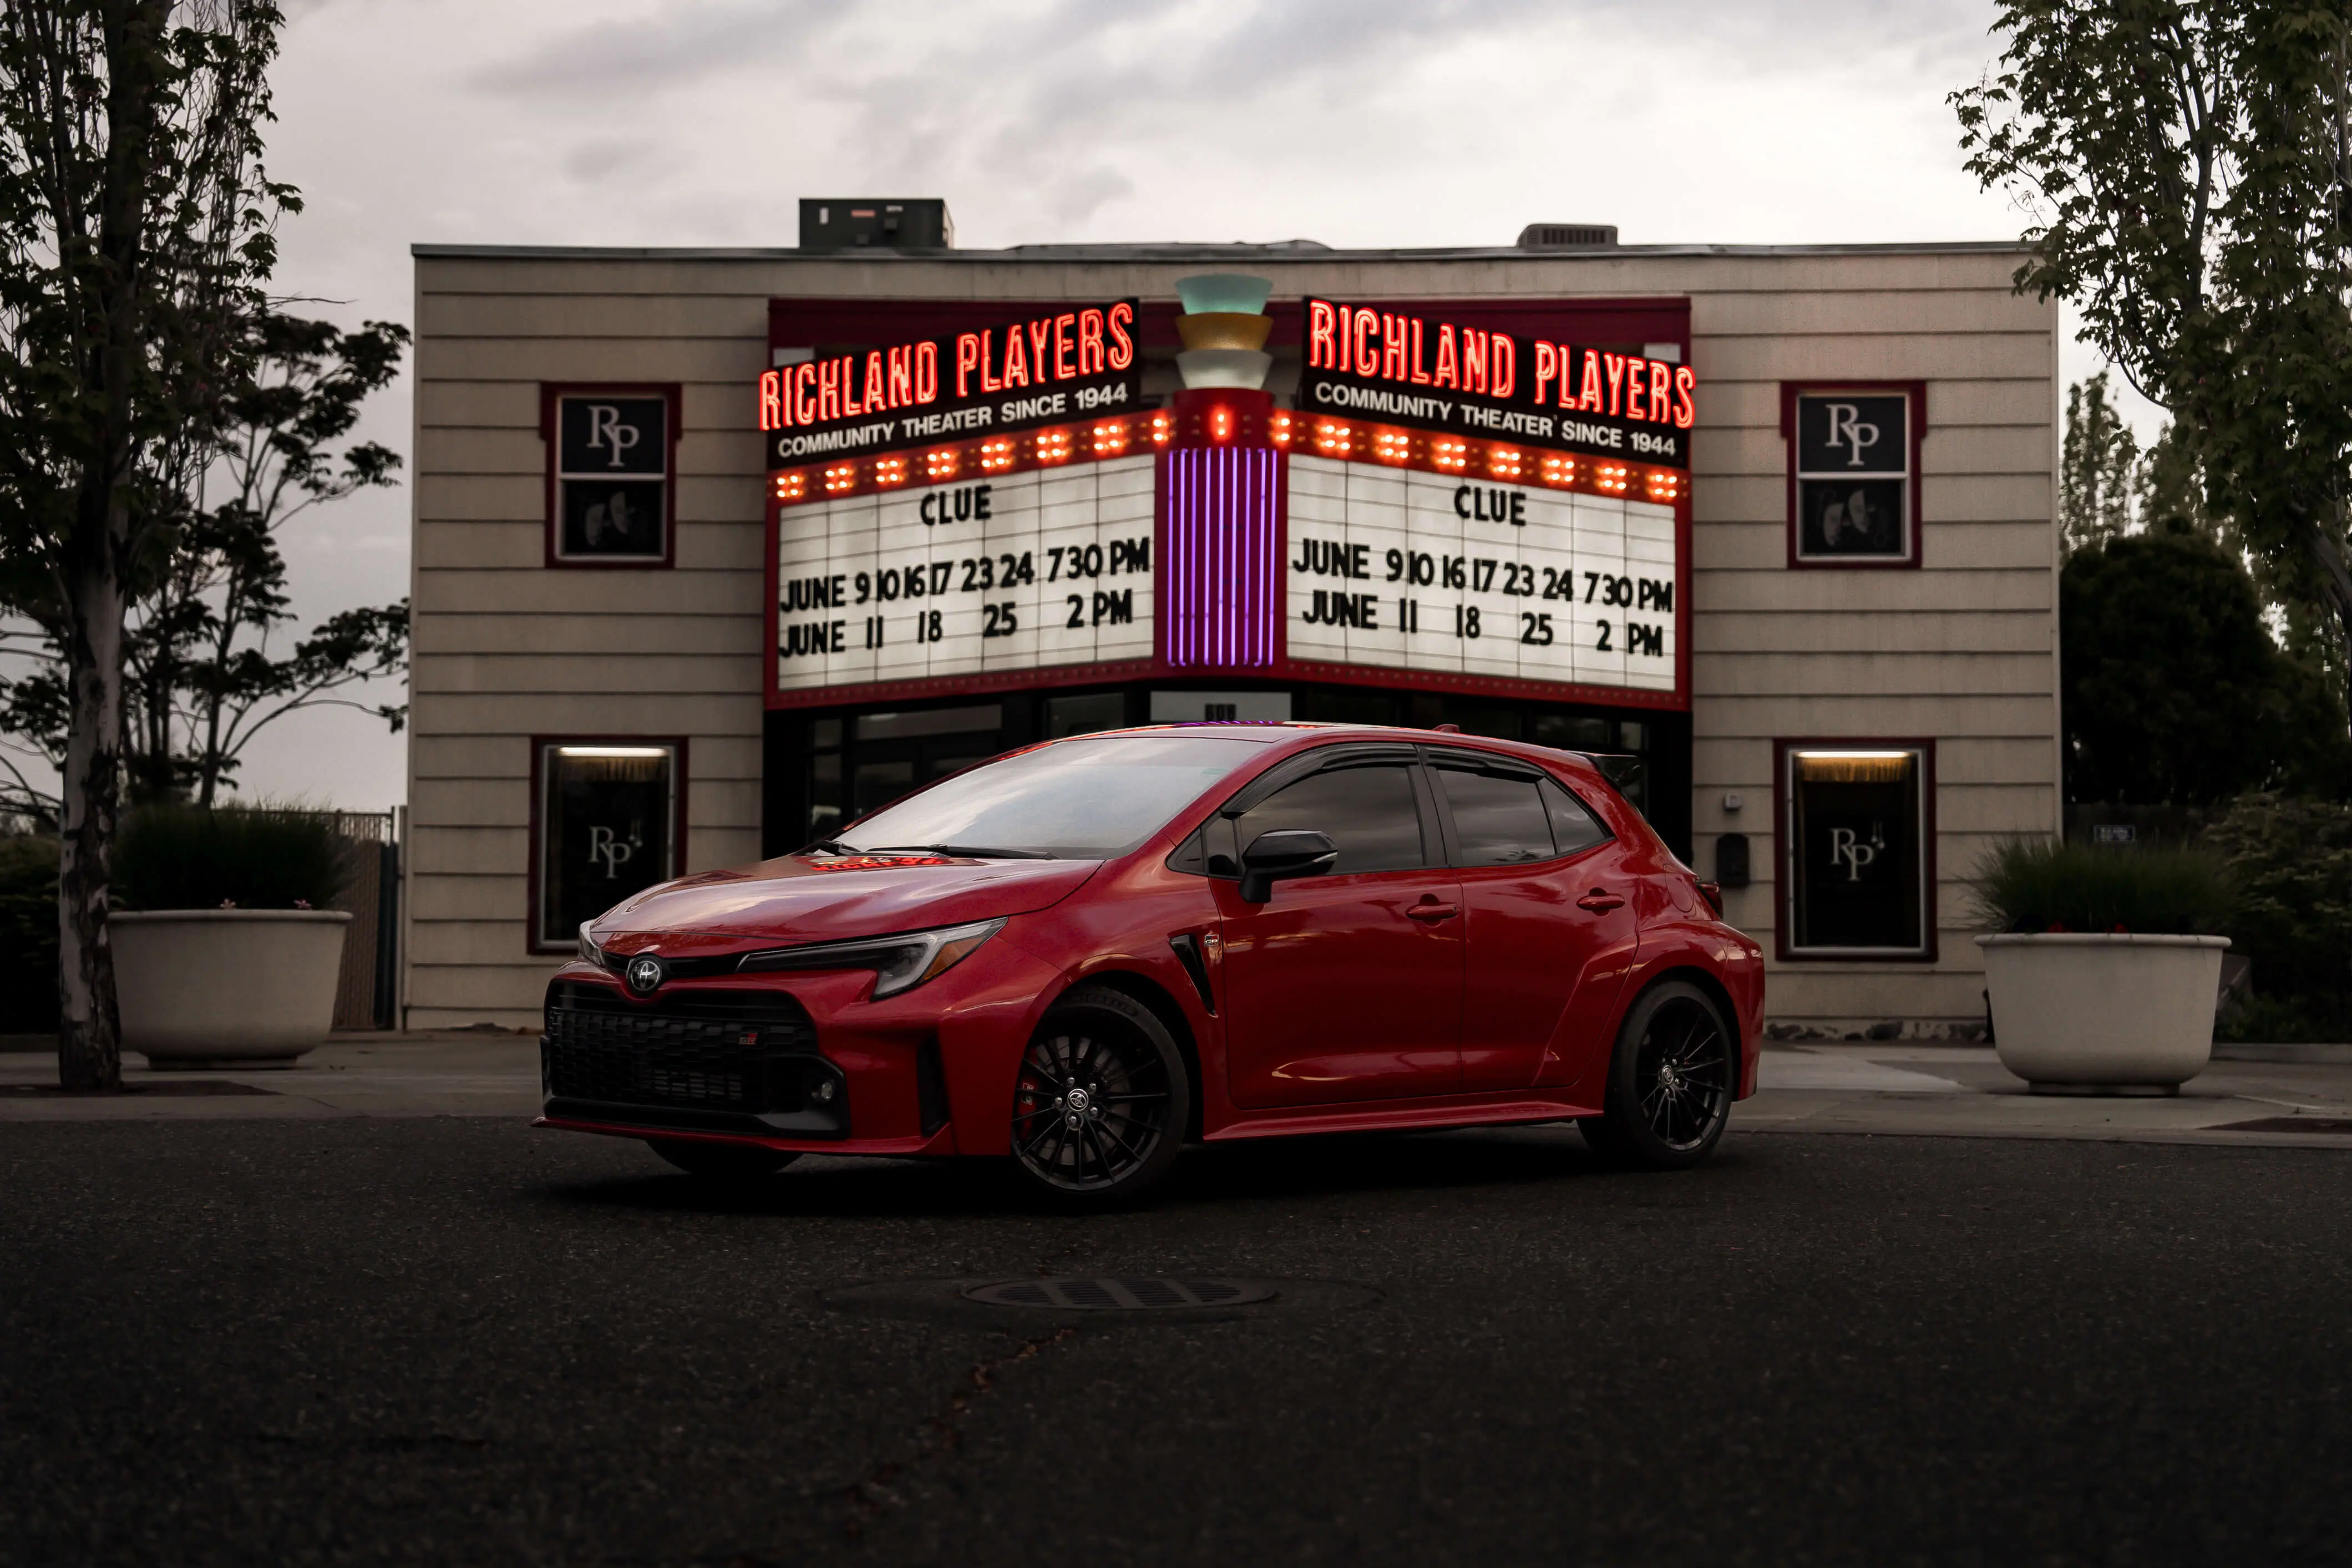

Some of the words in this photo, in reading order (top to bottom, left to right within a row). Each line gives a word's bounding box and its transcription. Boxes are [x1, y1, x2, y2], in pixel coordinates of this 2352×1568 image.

[760, 341, 938, 430] RICHLAND
[957, 302, 1133, 397] PLAYERS
[1309, 300, 1515, 398] RICHLAND
[1535, 341, 1696, 428] PLAYERS
[586, 405, 640, 466] RP
[778, 421, 895, 458] COMMUNITY
[903, 406, 992, 438] THEATER
[1001, 393, 1066, 423] SINCE
[1075, 382, 1127, 411] 1944
[1316, 382, 1452, 421] COMMUNITY
[1461, 405, 1553, 437] THEATER
[1562, 420, 1621, 448] SINCE
[1630, 432, 1675, 455] 1944
[1825, 404, 1880, 466] RP
[920, 484, 992, 526] CLUE
[1454, 485, 1526, 526] CLUE
[781, 575, 845, 612] JUNE
[855, 572, 869, 604] 9
[877, 568, 900, 602] 10
[904, 565, 925, 598] 16
[931, 561, 953, 595] 17
[961, 557, 993, 592] 23
[1000, 552, 1034, 587] 24
[1110, 537, 1150, 576] PM
[1293, 538, 1370, 580] JUNE
[1386, 549, 1402, 581] 9
[1410, 553, 1433, 586] 10
[1443, 554, 1466, 589] 16
[1473, 559, 1497, 592] 17
[1503, 563, 1534, 597] 23
[1543, 567, 1573, 602] 24
[1638, 579, 1672, 613] PM
[778, 621, 845, 658] JUNE
[866, 616, 883, 649] 11
[918, 611, 941, 643] 18
[982, 602, 1017, 637] 25
[1067, 595, 1083, 628] 2
[1092, 588, 1132, 626] PM
[1302, 590, 1378, 630] JUNE
[1400, 597, 1417, 633] 11
[1456, 605, 1481, 638] 18
[1520, 613, 1553, 645] 25
[1596, 620, 1613, 652] 2
[1628, 623, 1663, 657] PM
